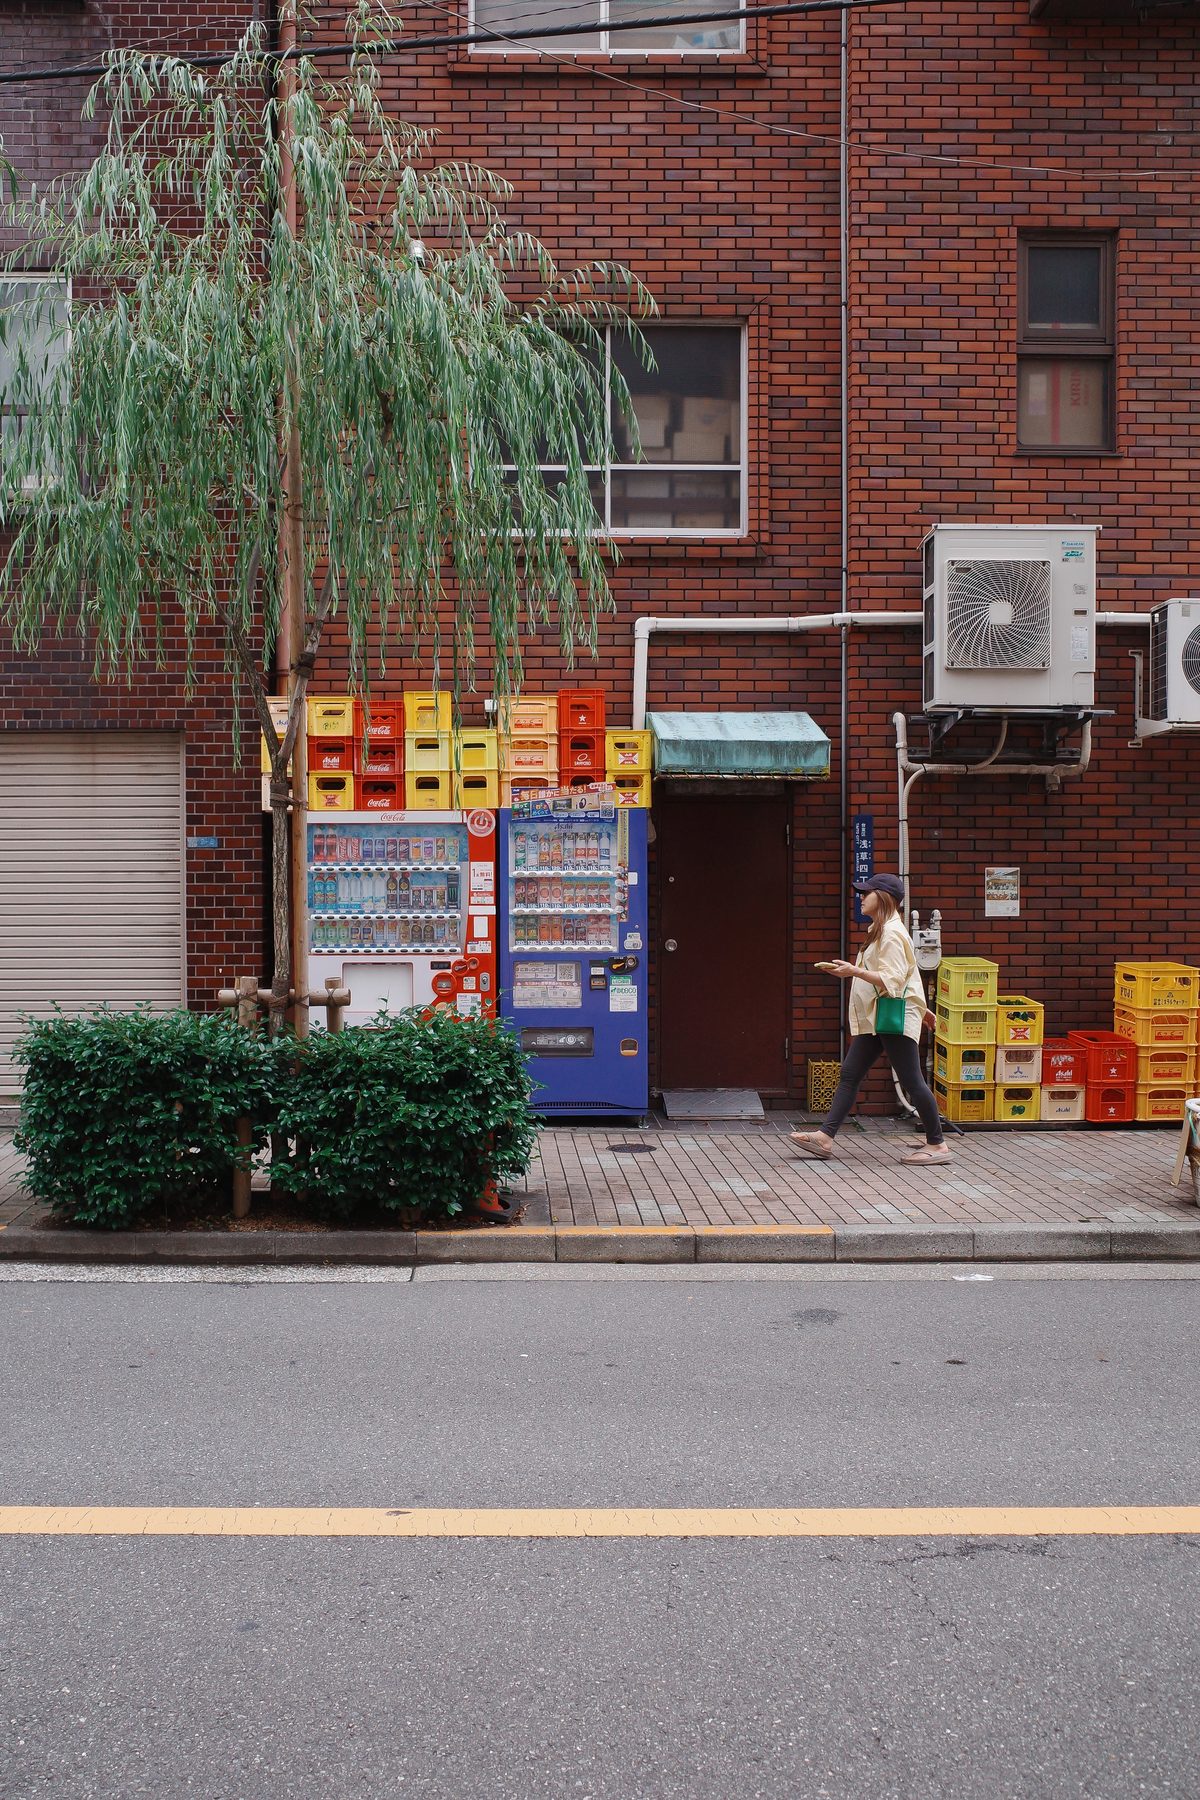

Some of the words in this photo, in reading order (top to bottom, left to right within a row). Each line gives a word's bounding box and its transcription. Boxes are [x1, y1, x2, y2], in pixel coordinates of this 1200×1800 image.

[368, 799, 391, 807] Coca-Cola
[381, 812, 406, 821] Coca-Cola
[1120, 986, 1133, 999] FUJI
